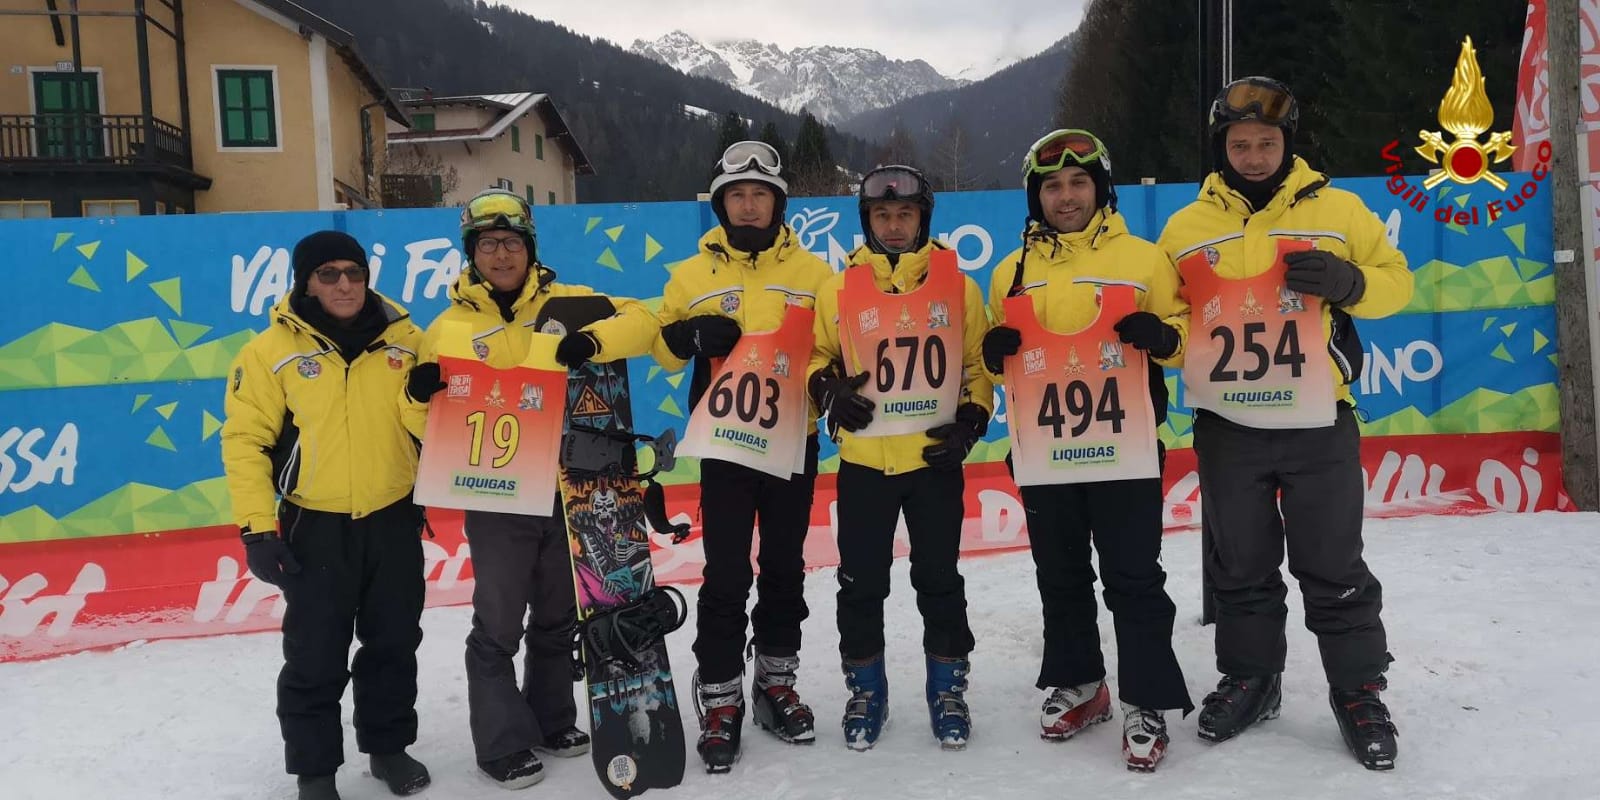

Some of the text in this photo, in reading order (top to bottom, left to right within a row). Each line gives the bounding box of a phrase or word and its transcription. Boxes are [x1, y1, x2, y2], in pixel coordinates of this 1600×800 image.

[231, 245, 294, 316] VA
[876, 334, 947, 393] 670
[1209, 319, 1306, 382] 254
[708, 371, 780, 430] 603
[884, 399, 938, 414] LIQUIGAS
[1037, 376, 1126, 439] 494
[1223, 390, 1293, 402] LIQUIGAS
[466, 410, 521, 469] 19
[714, 427, 768, 450] LIQUIGAS
[1052, 445, 1115, 462] LIQUIGAS
[453, 475, 517, 491] LIQUIGAS
